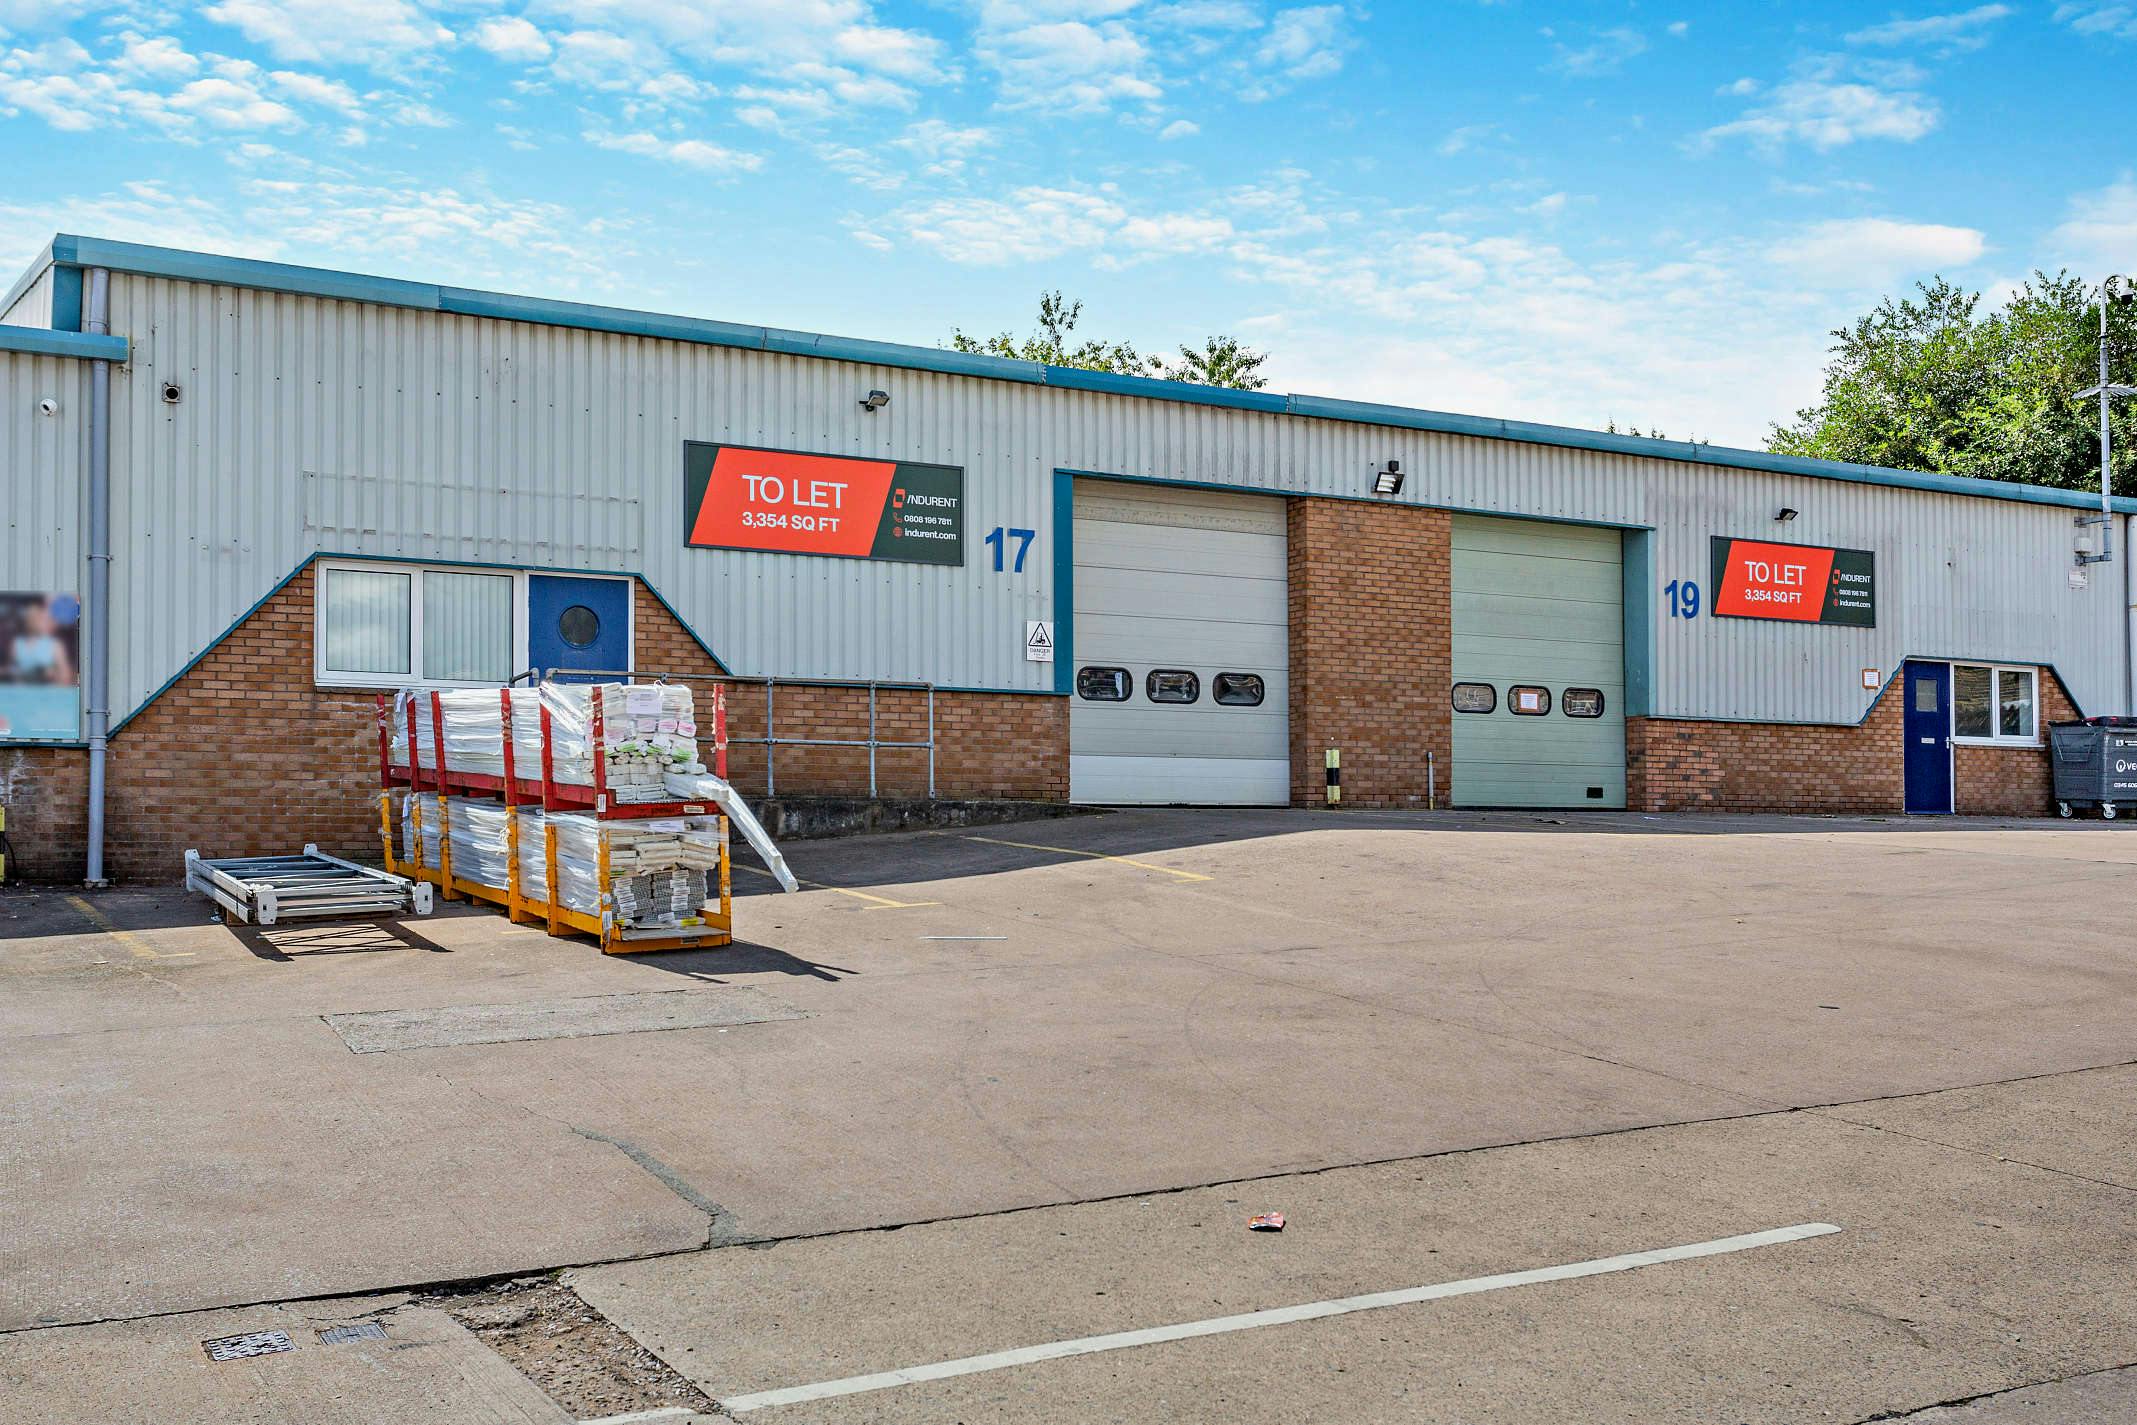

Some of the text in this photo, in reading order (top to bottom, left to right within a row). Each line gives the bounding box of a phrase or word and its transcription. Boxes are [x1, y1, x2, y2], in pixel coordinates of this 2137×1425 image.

[742, 474, 848, 509] TO LET
[742, 511, 840, 532] 3,354 SQ FT
[904, 514, 924, 524] 0808
[985, 527, 1035, 573] 17
[1744, 560, 1807, 586] TO LET
[1664, 579, 1700, 620] 19
[1744, 588, 1803, 604] 3,354 SQ FT
